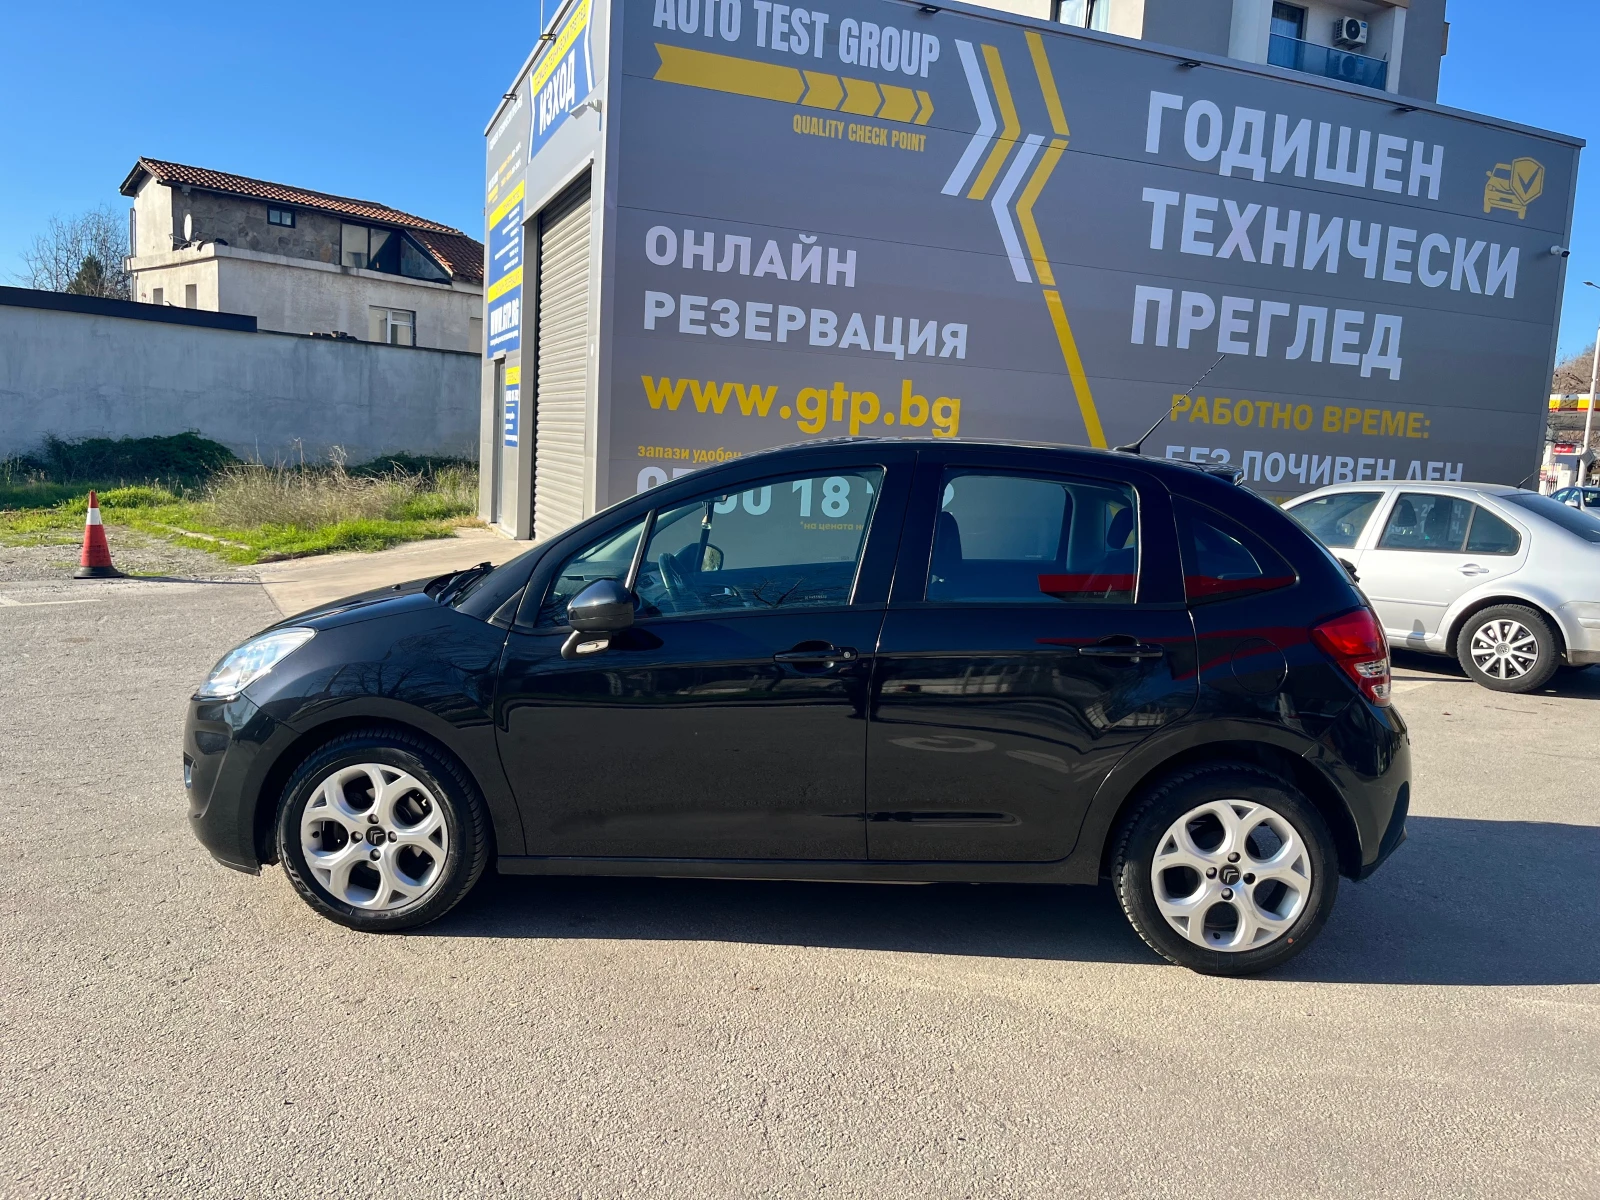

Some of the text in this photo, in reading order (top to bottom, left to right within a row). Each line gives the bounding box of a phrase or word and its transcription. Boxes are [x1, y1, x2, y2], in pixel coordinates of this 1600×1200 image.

[653, 0, 940, 78] AUTO TEST GROUP
[539, 48, 576, 136] ИЗХОД
[793, 114, 926, 152] QUALITY CHECK POINT
[1145, 90, 1444, 201] ГОДИШЕН
[645, 225, 857, 287] ОНЛАЙН
[1142, 187, 1520, 299] ТЕХНИЧЕСКИ
[643, 290, 968, 361] РЕЗЕРВАЦИЯ
[1131, 285, 1403, 381] ПРЕГЛЕД
[641, 375, 961, 438] www.gtp.bg
[1170, 394, 1431, 439] РАБОТНО ВРЕМЕ:
[637, 445, 690, 460] запази
[1242, 450, 1396, 485] ПОЧИВЕН
[792, 476, 851, 518] 18
